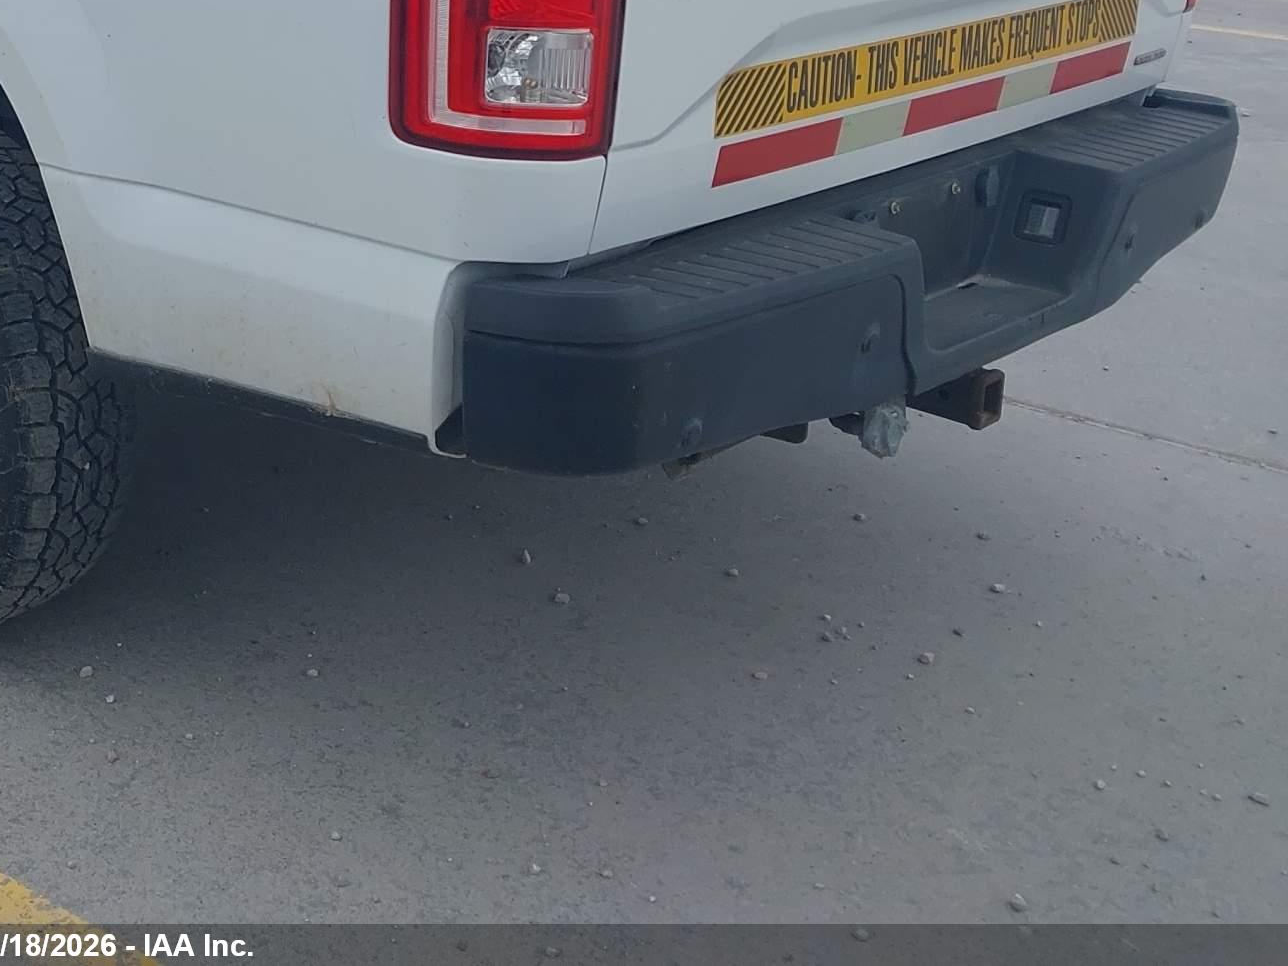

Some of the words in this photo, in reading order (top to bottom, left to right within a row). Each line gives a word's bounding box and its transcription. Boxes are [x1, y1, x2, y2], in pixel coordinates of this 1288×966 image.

[867, 40, 900, 95] THIS
[902, 27, 958, 86] VEHICLE
[958, 17, 1006, 73] MAKES
[1006, 4, 1066, 61] FREQUENT
